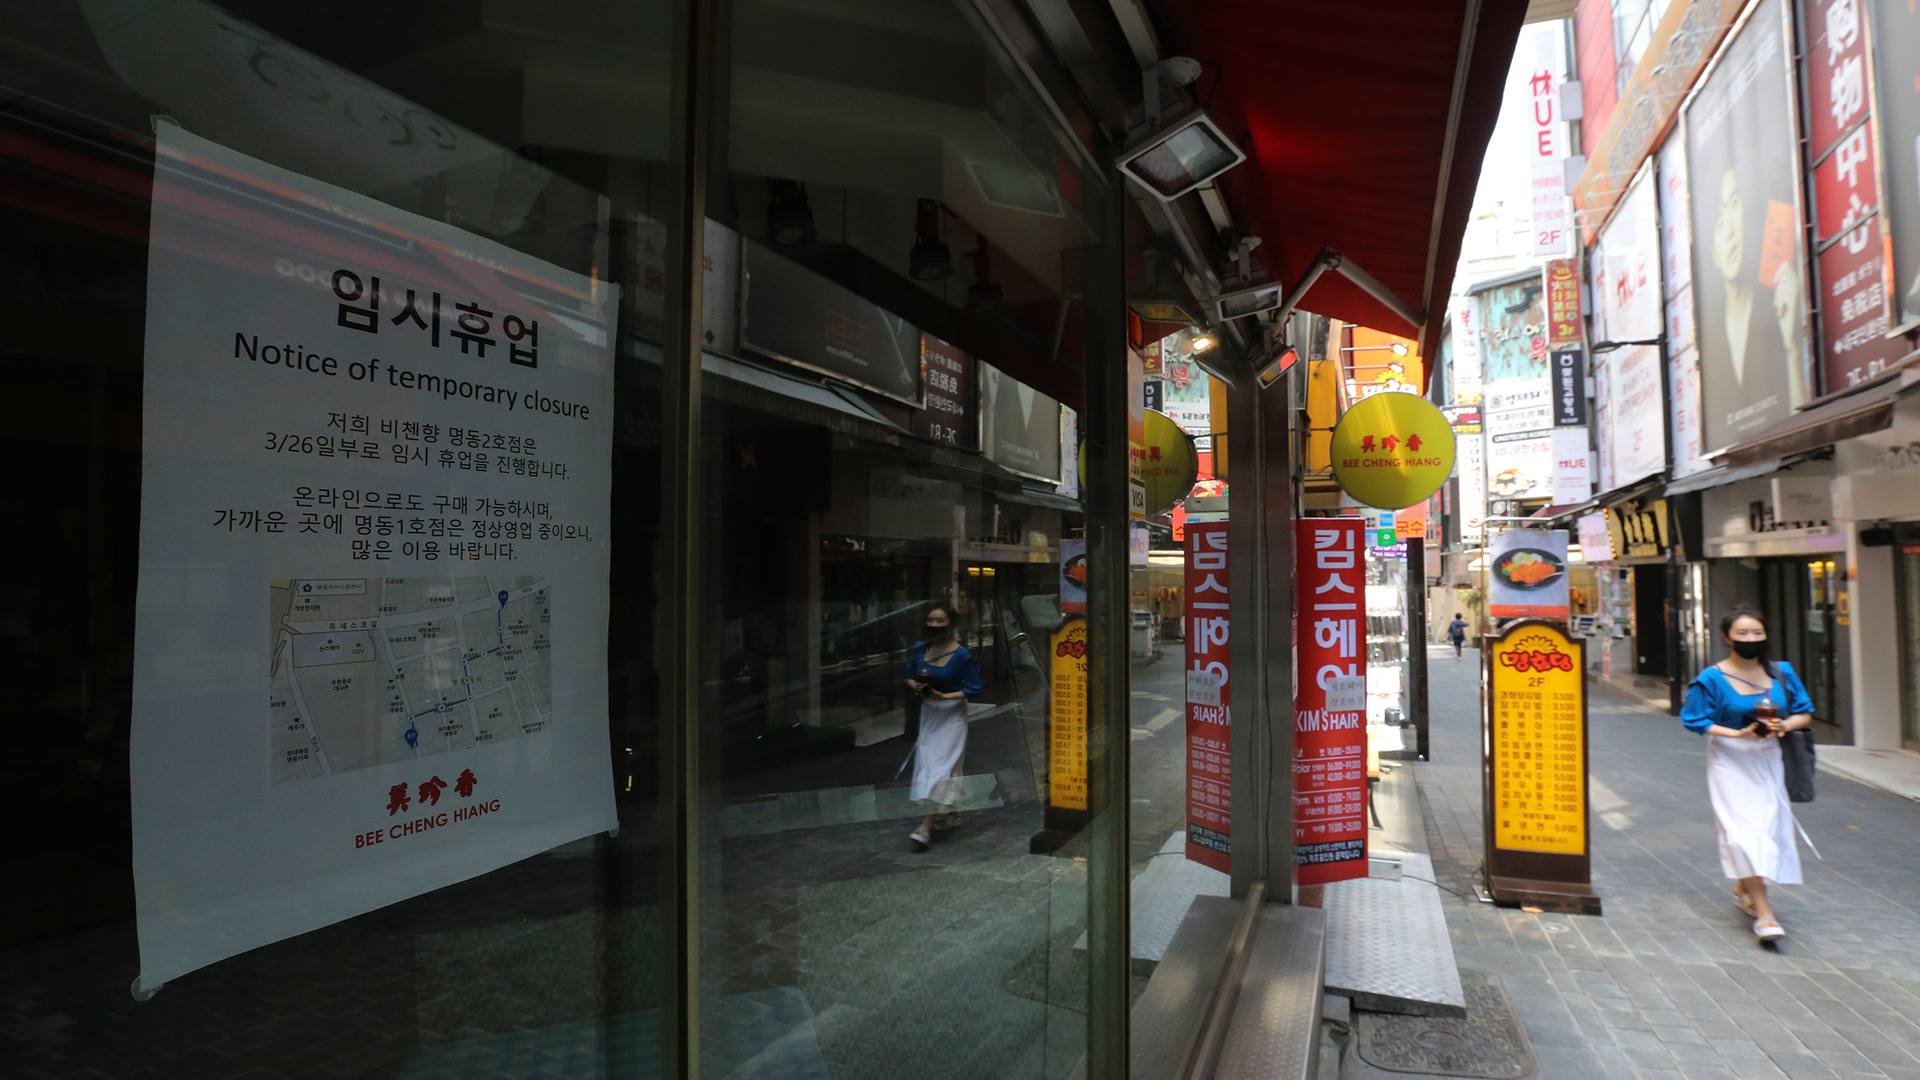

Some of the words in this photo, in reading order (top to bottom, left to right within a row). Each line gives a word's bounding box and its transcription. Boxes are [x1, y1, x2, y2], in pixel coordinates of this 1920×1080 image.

[1539, 230, 1562, 245] 2F
[331, 270, 538, 368] 임시휴업
[235, 332, 338, 376] Notice
[349, 359, 380, 382] of
[387, 365, 517, 410] temporary
[524, 390, 590, 420] closure
[328, 412, 369, 436] 저희
[381, 418, 440, 444] 비첸향
[449, 427, 537, 456] 명동2호점은
[265, 432, 381, 459] 3/26일부로
[392, 444, 429, 466] 임시
[438, 449, 490, 472] 휴업을
[497, 456, 570, 480] 진행합니다.
[1343, 459, 1360, 468] BEE
[1362, 458, 1402, 468] CHENG
[1405, 458, 1442, 466] HIANG
[293, 486, 424, 510] 온라인으로도
[433, 496, 468, 516] 구매
[476, 498, 552, 520] 가능하시며,
[1132, 490, 1144, 508] VISA
[213, 509, 287, 533] 가까운
[298, 512, 342, 534] 곳에
[355, 516, 464, 538] 명동1호점은
[472, 520, 532, 540] 정상영업
[538, 522, 592, 542] 중이오니,
[1397, 521, 1423, 534] 국수
[352, 540, 392, 560] 많은
[402, 541, 440, 561] 이용
[450, 542, 517, 561] 바랍니다.
[1314, 530, 1357, 691] 킴스헤어
[329, 621, 378, 630] 유네스코길
[1528, 677, 1545, 688] 2F
[1330, 712, 1360, 730] HAIR
[356, 829, 384, 849] BEE
[390, 813, 448, 840] CHENG
[454, 800, 500, 822] HIANG
